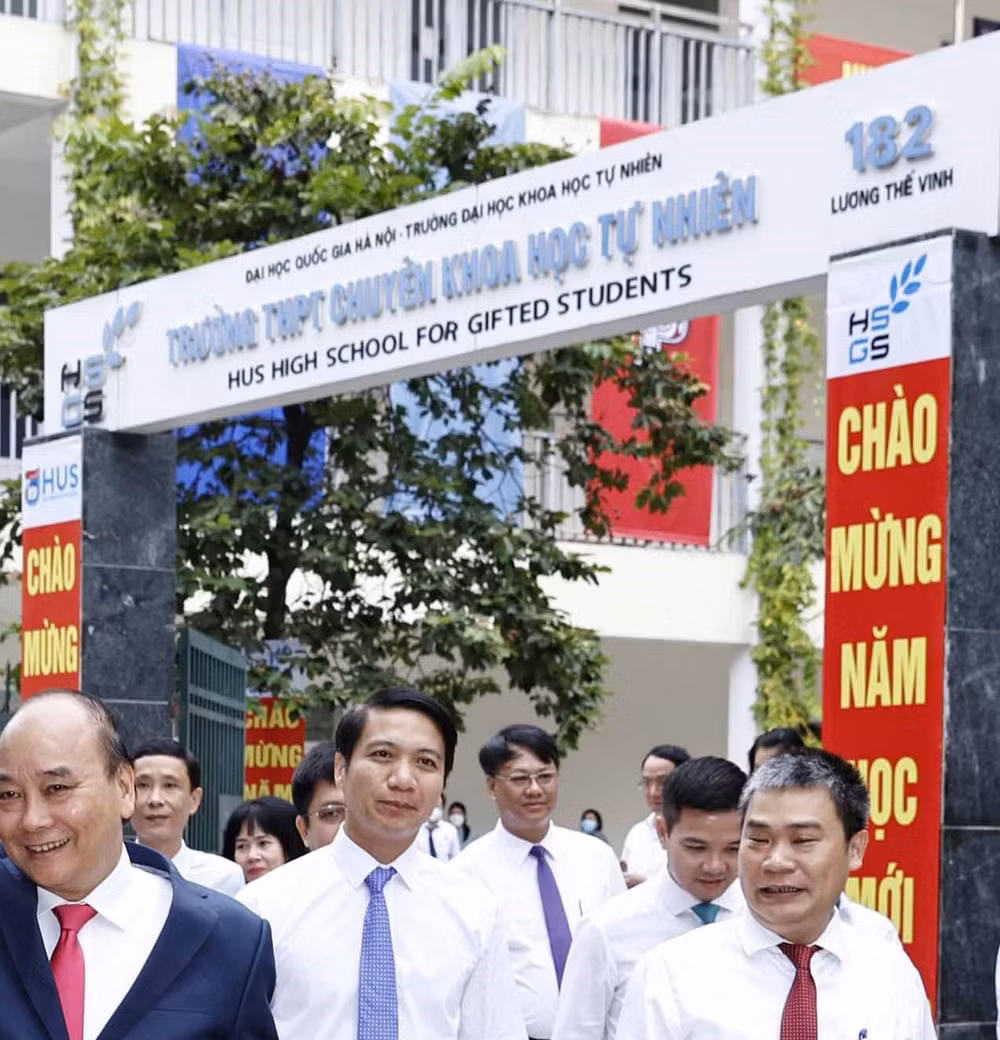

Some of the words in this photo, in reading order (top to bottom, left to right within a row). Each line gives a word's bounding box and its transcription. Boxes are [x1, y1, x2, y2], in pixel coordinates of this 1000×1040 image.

[844, 105, 934, 173] 182
[268, 259, 291, 278] HỌC
[295, 245, 328, 269] QUỐC
[332, 242, 352, 259] GIA
[355, 235, 372, 253] HÀ
[375, 226, 397, 247] NỘI
[487, 196, 514, 217] HỌC
[518, 185, 557, 208] KHOA
[561, 175, 592, 197] HỌC
[596, 164, 616, 187] TỰ
[620, 152, 663, 179] NHIÊN
[884, 169, 916, 201] THẾ
[918, 167, 954, 193] VINH
[263, 289, 326, 344] THPT
[330, 256, 437, 327] CHUYÊN
[441, 239, 521, 300] KHOA
[528, 220, 590, 284] HỌC
[598, 200, 643, 266] TỰ
[653, 170, 759, 248] NHIÊN
[228, 364, 264, 390] HUS
[271, 350, 318, 381] HIGH
[326, 331, 409, 368] SCHOOL
[416, 320, 458, 347] FOR
[468, 298, 550, 336] GIFTED
[558, 263, 693, 315] STUDENTS
[838, 384, 938, 476] CHÀO
[42, 463, 79, 494] HUS
[26, 535, 76, 596] CHÀO
[830, 507, 942, 593] MỪNG
[23, 618, 79, 678] MỪNG
[840, 625, 927, 709] NĂM
[848, 757, 918, 841] ỌC
